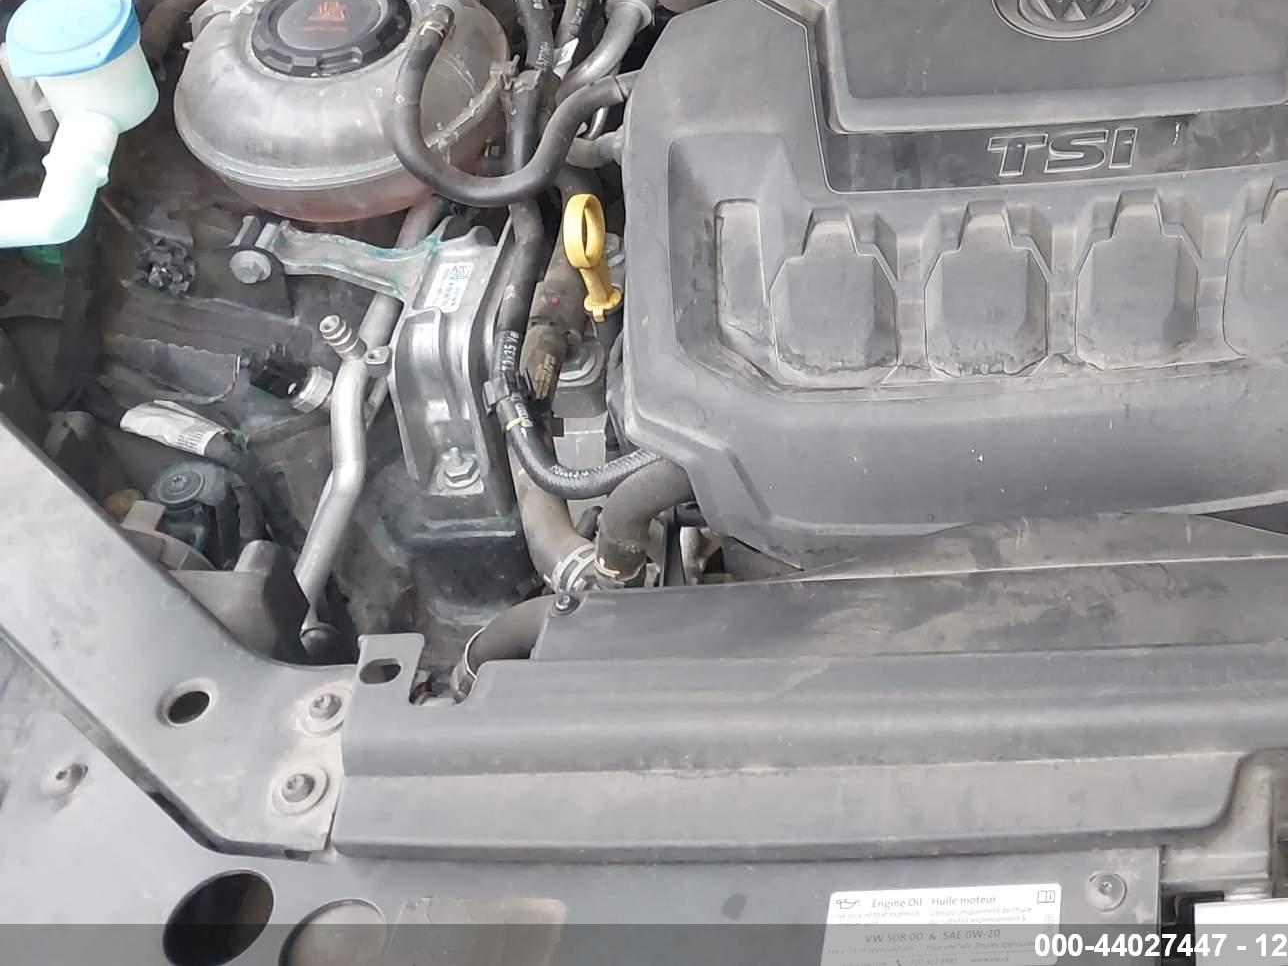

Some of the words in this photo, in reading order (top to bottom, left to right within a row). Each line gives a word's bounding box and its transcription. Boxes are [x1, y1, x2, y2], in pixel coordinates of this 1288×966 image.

[987, 127, 1138, 177] TSI
[872, 898, 906, 910] Engine
[908, 897, 922, 907] Oil
[931, 896, 958, 906] Huile
[960, 895, 996, 905] moteur
[864, 933, 884, 943] VW
[887, 932, 906, 943] 508
[908, 932, 924, 942] 00
[928, 932, 937, 941] &
[943, 930, 962, 940] SAE
